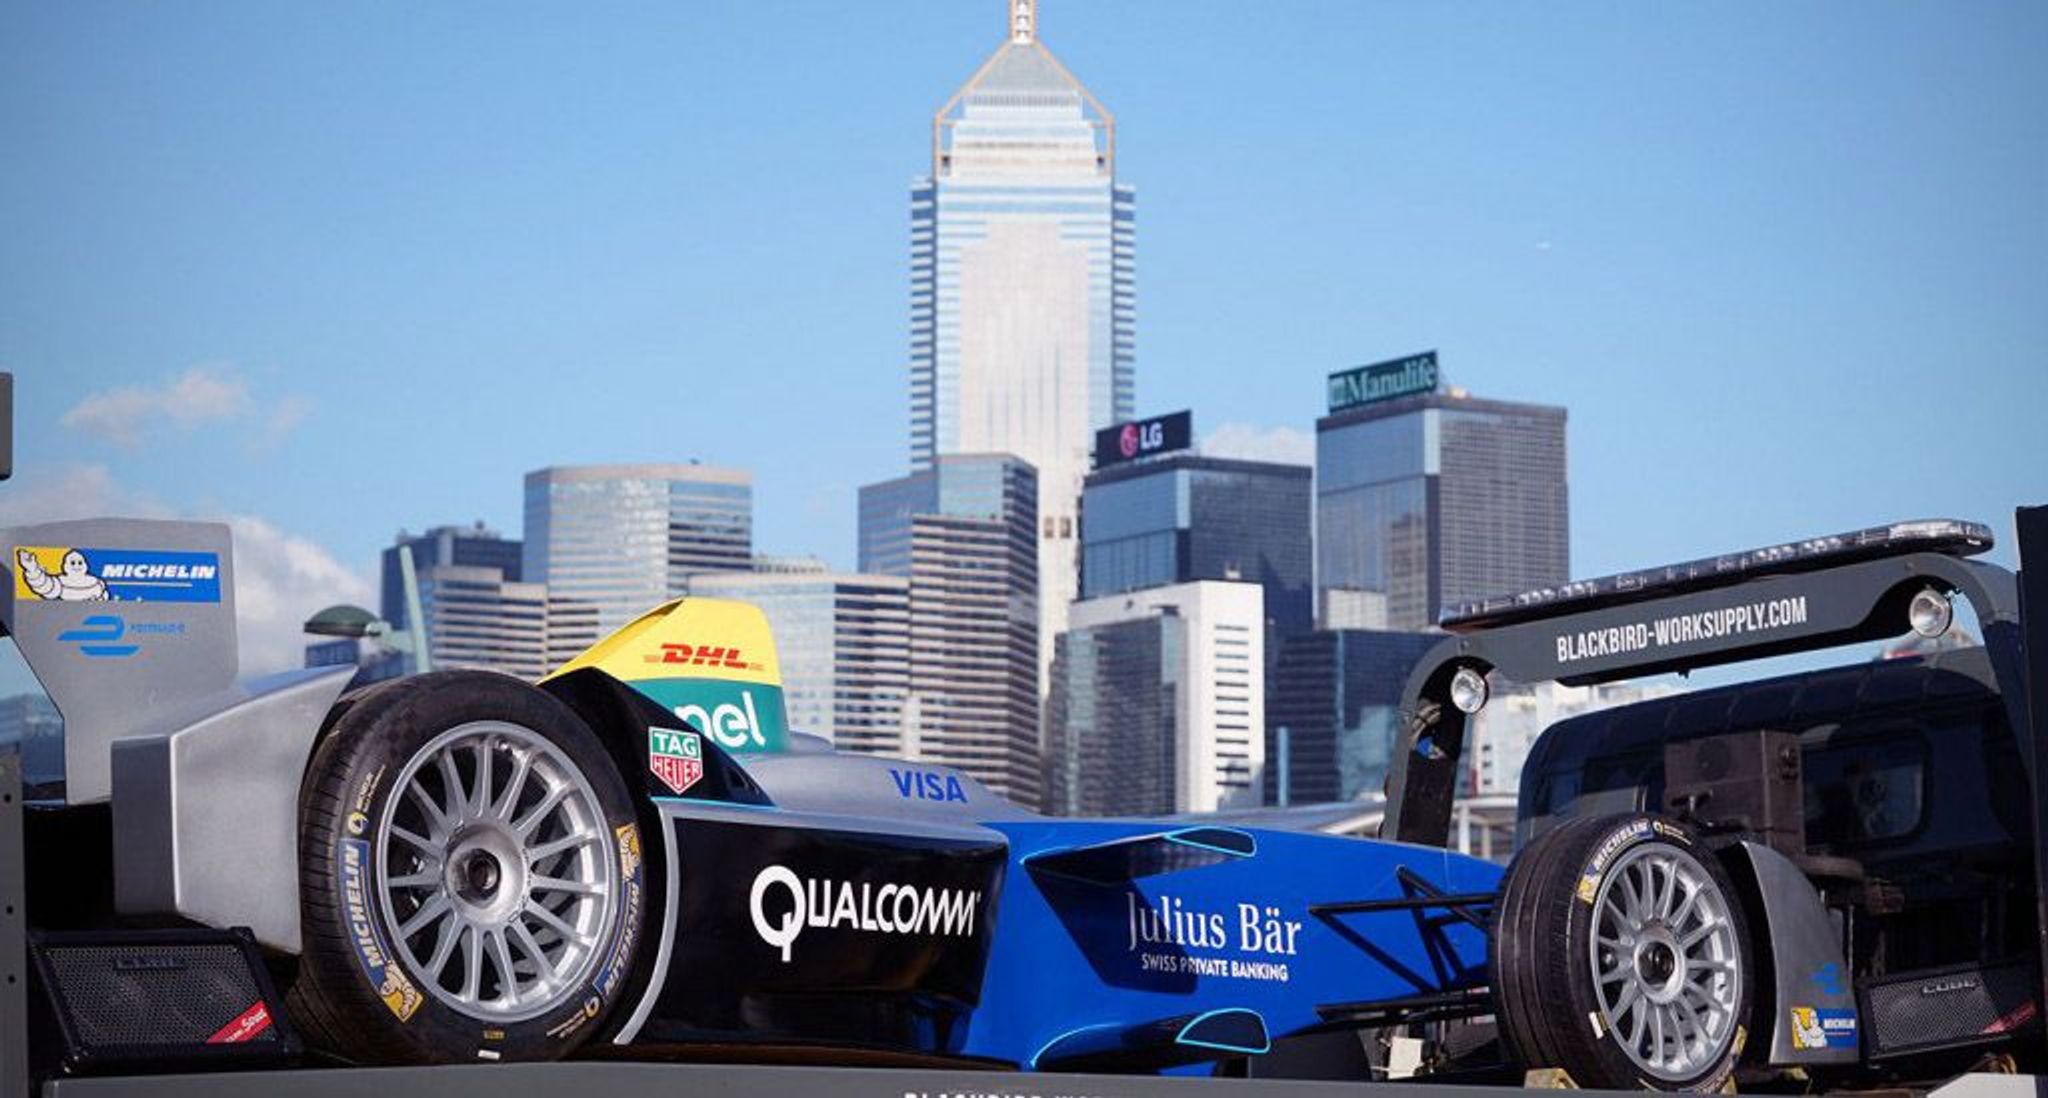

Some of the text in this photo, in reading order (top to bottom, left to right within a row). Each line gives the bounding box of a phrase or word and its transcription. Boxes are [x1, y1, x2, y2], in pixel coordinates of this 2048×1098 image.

[1346, 356, 1436, 403] Manulife
[1140, 421, 1164, 451] LG
[102, 563, 217, 580] MICHELIN
[1556, 596, 1808, 663] BLACKBIRD-WORKSUPPLY.COM
[660, 643, 749, 670] DHL
[654, 732, 698, 757] TAG
[652, 756, 701, 791] HEUER
[889, 768, 969, 804] VISA
[344, 845, 384, 968] MICHELIN
[750, 864, 976, 963] QUALCOMM
[1125, 891, 1302, 956] Julius Bär
[1141, 952, 1290, 982] SWISS PRIVATE BANKING
